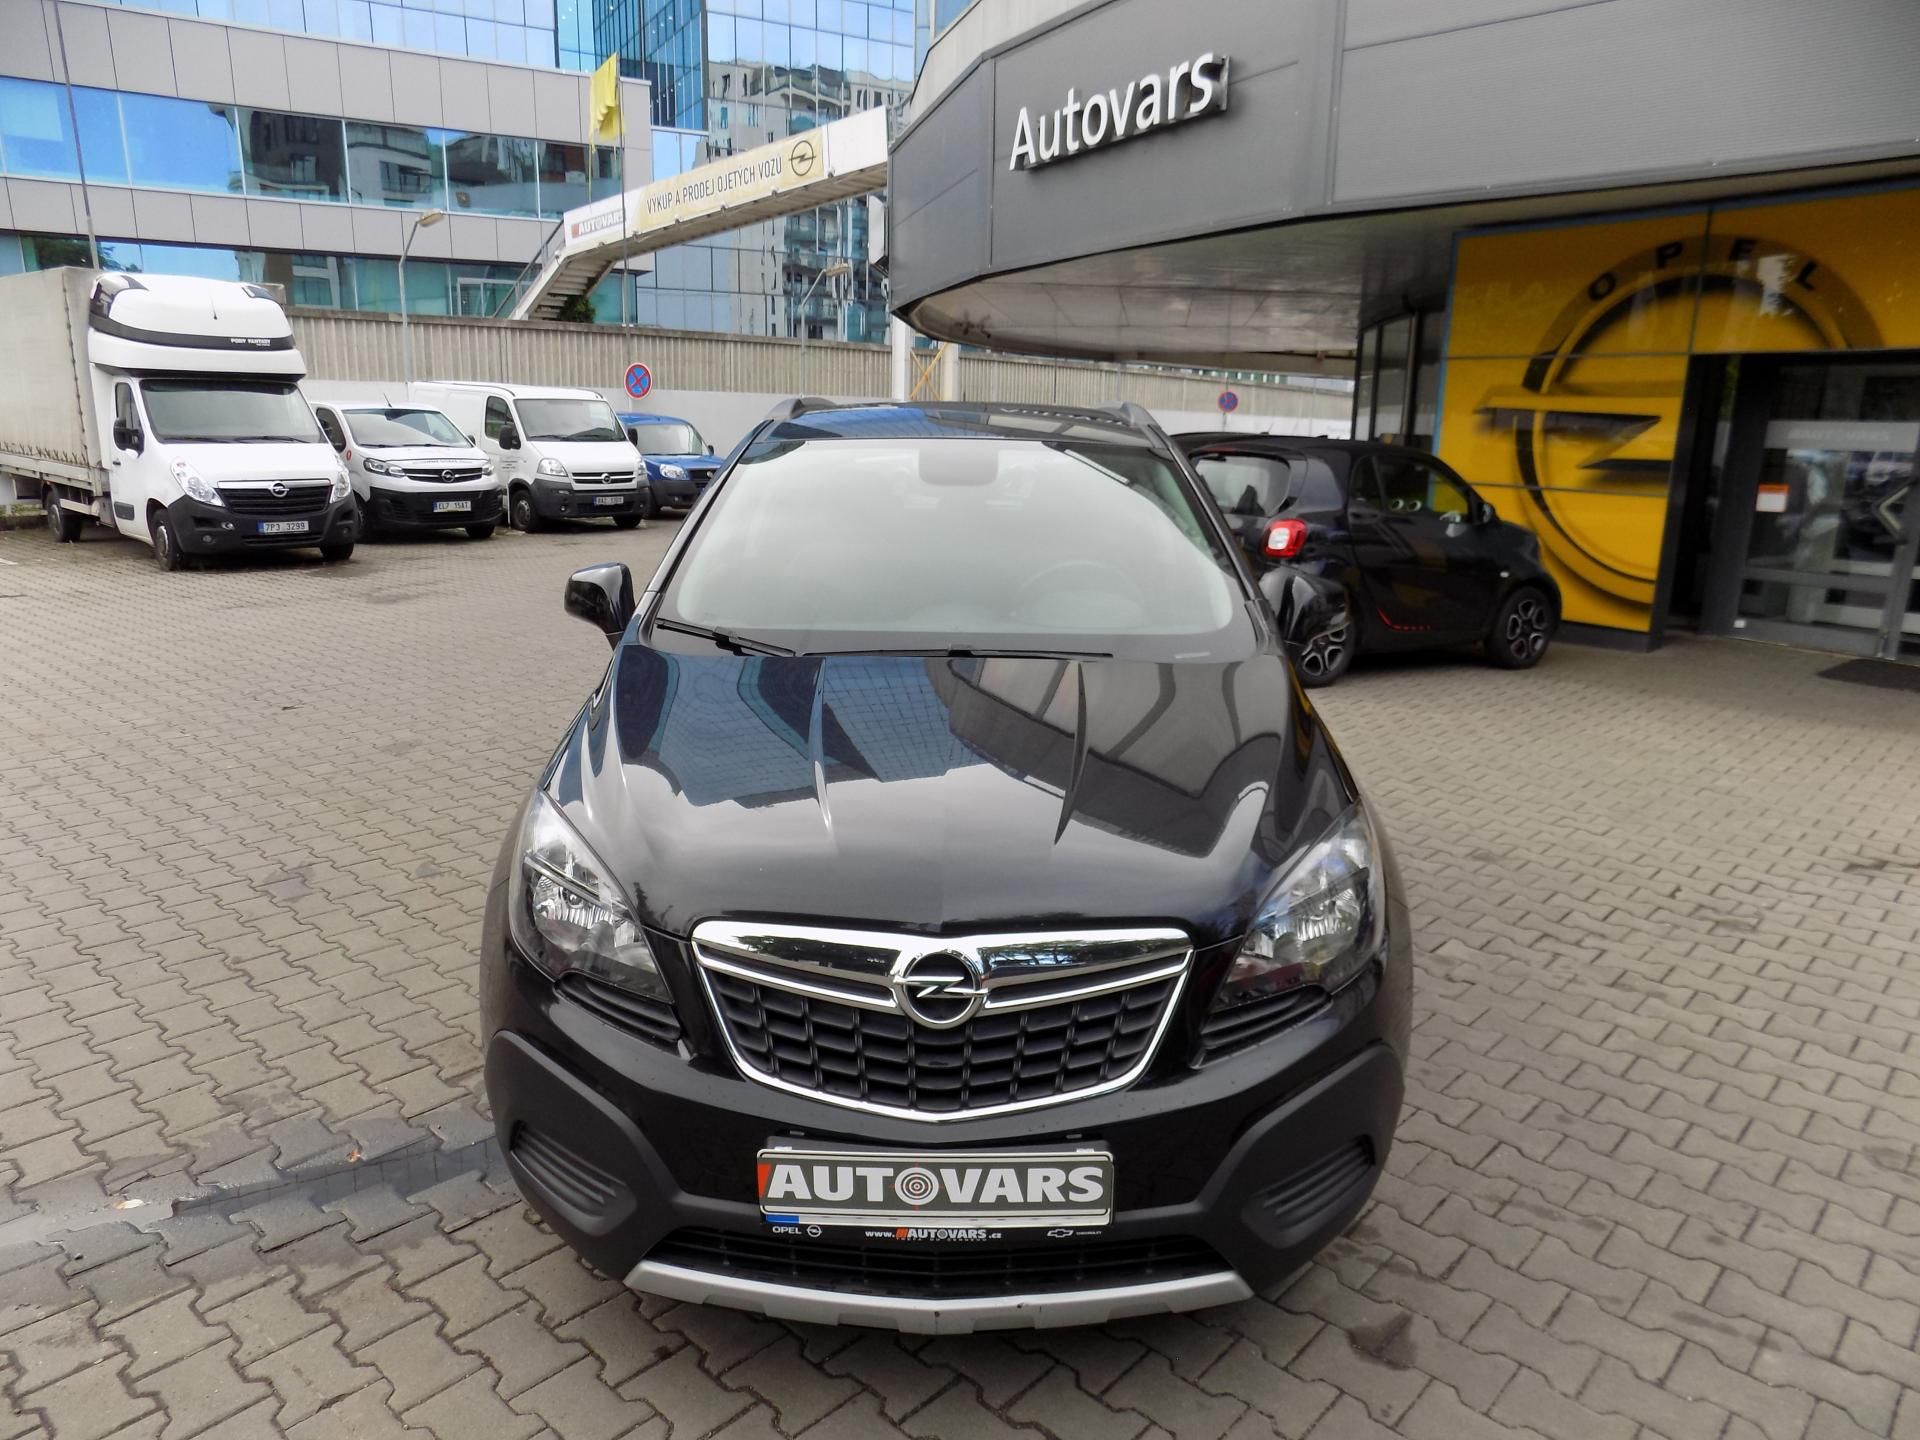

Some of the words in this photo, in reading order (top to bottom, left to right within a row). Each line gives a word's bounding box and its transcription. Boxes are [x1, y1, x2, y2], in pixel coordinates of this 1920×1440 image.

[1009, 52, 1215, 170] Autovars
[675, 190, 681, 206] A
[683, 179, 715, 203] PRODEJ
[1587, 237, 1819, 301] OPEL
[286, 522, 305, 531] 3299
[767, 1164, 1104, 1206] AUTOVARS
[772, 1225, 802, 1235] OPEL
